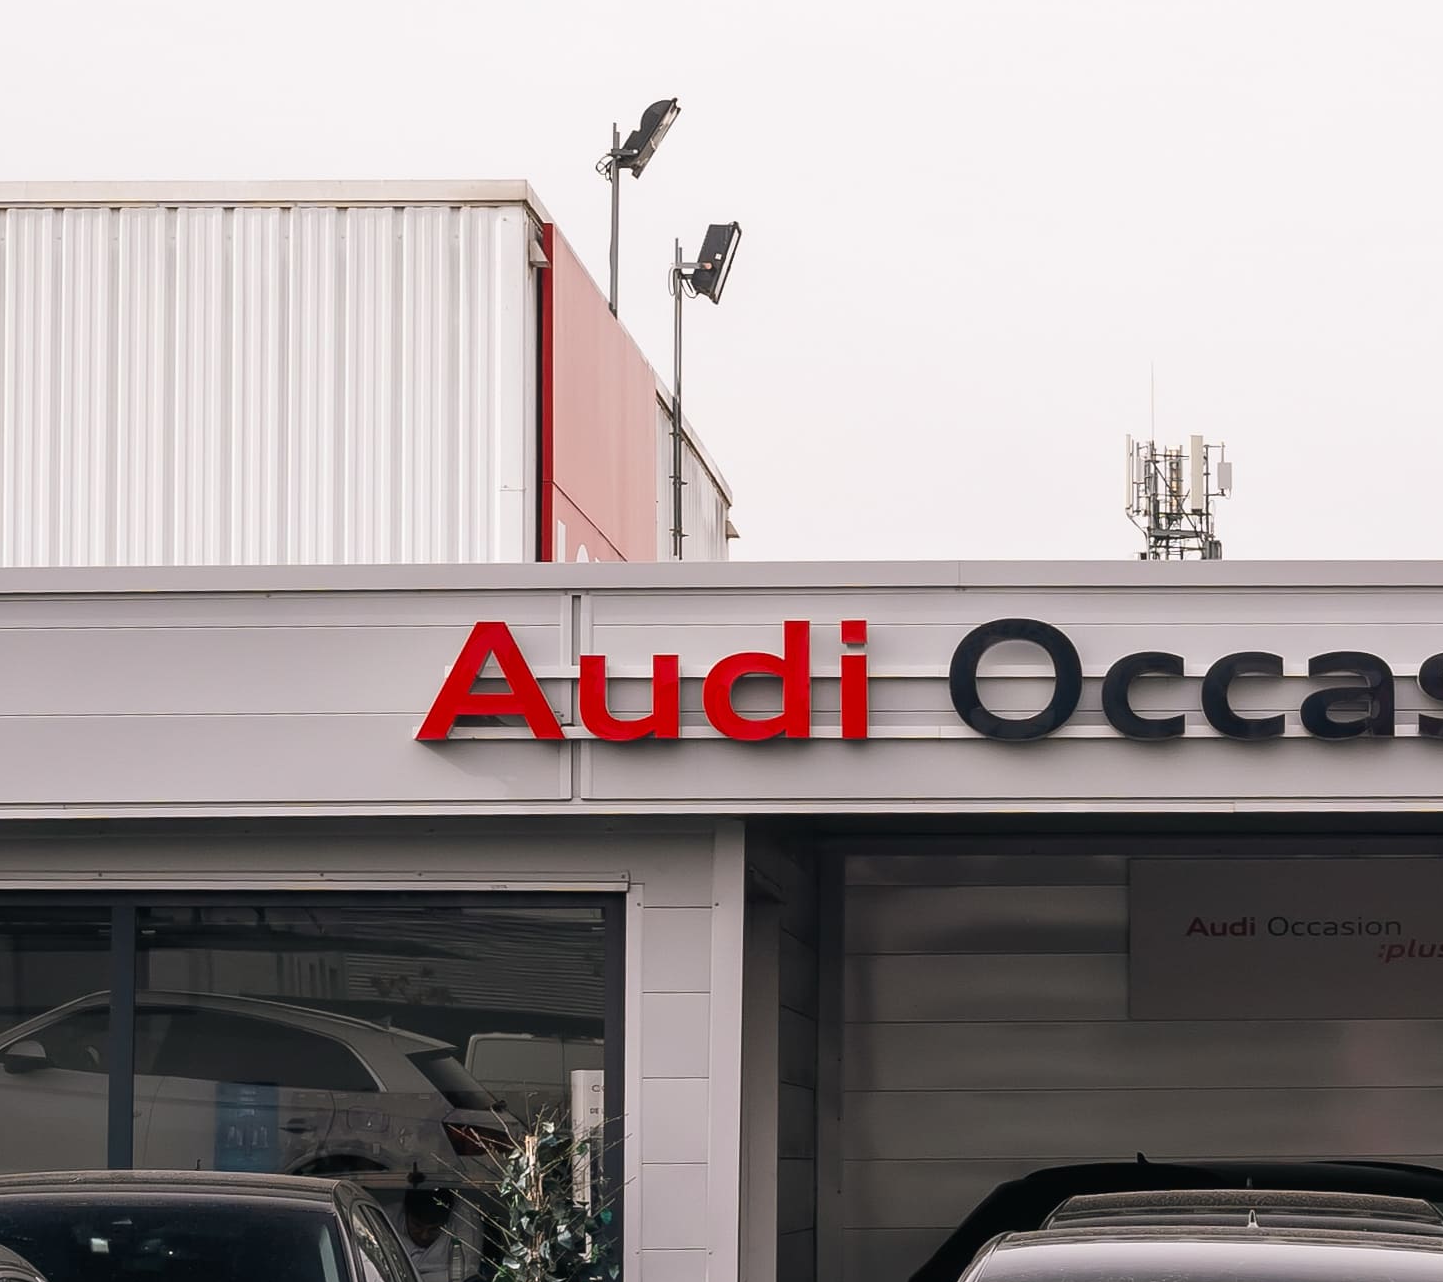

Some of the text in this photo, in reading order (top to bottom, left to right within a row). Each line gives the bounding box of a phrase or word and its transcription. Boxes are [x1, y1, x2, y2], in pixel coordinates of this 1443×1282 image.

[414, 619, 869, 741] Audi
[1185, 916, 1402, 937] Audi Occasion
